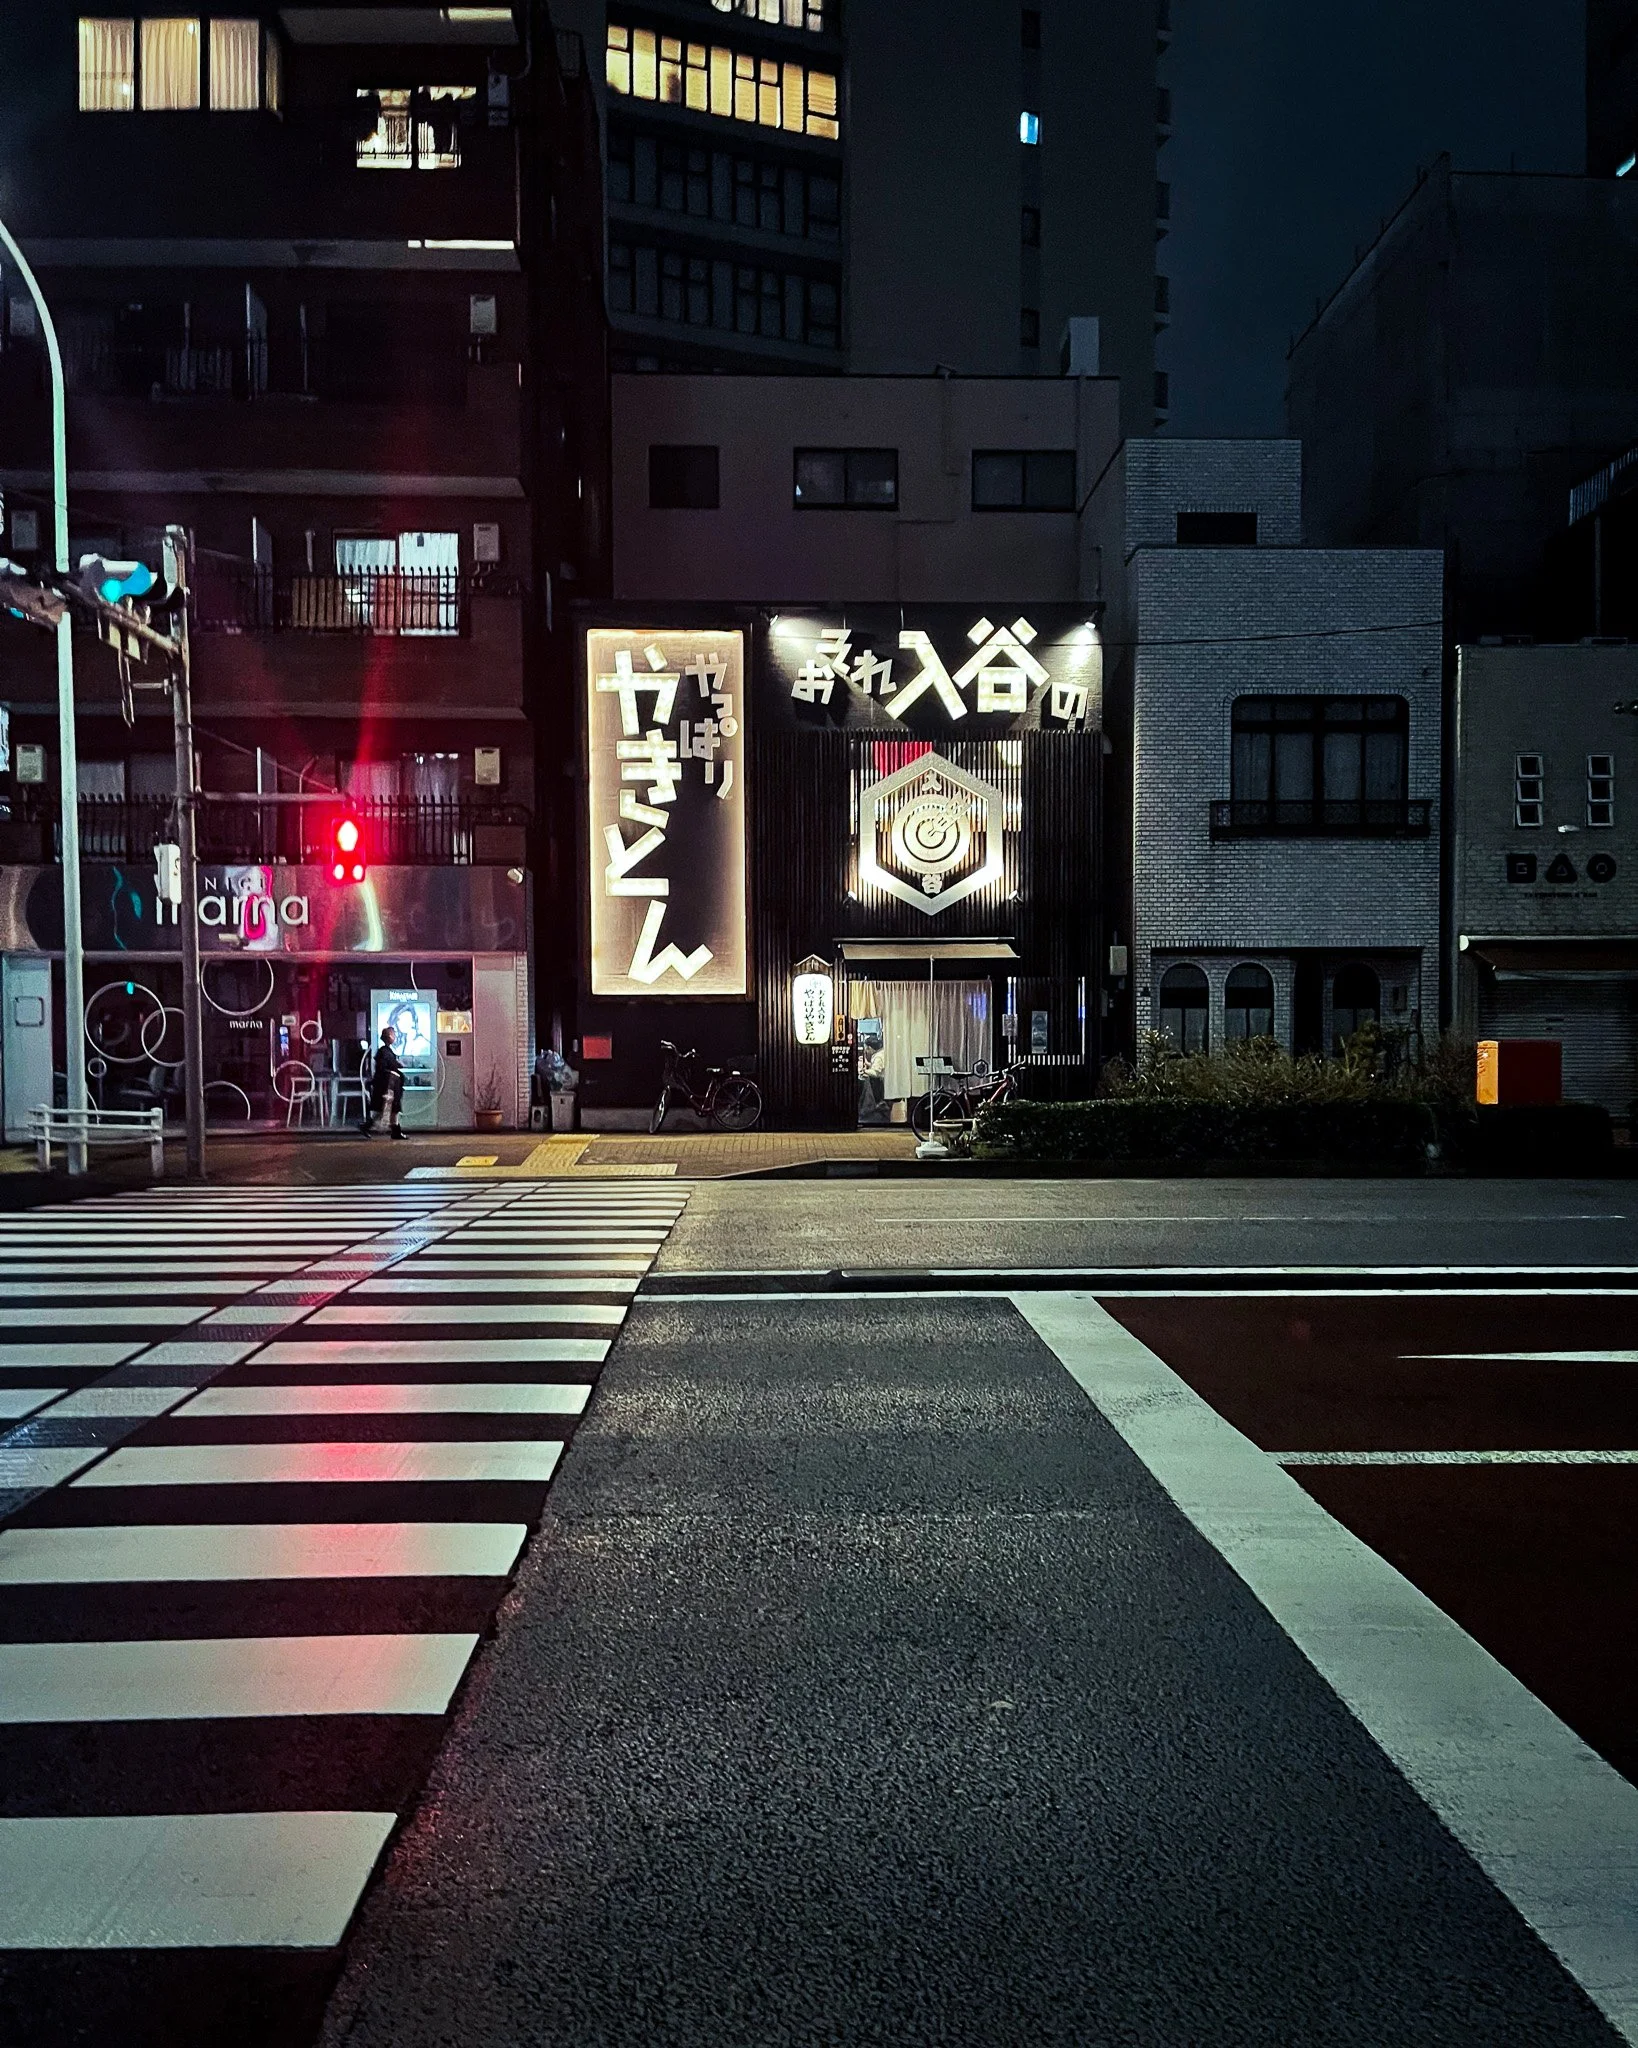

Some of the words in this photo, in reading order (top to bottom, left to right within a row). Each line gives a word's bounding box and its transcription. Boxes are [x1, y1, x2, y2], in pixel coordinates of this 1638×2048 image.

[680, 652, 738, 800] やっぱり
[791, 617, 1088, 720] おそれ入谷の
[596, 643, 713, 984] やきとん
